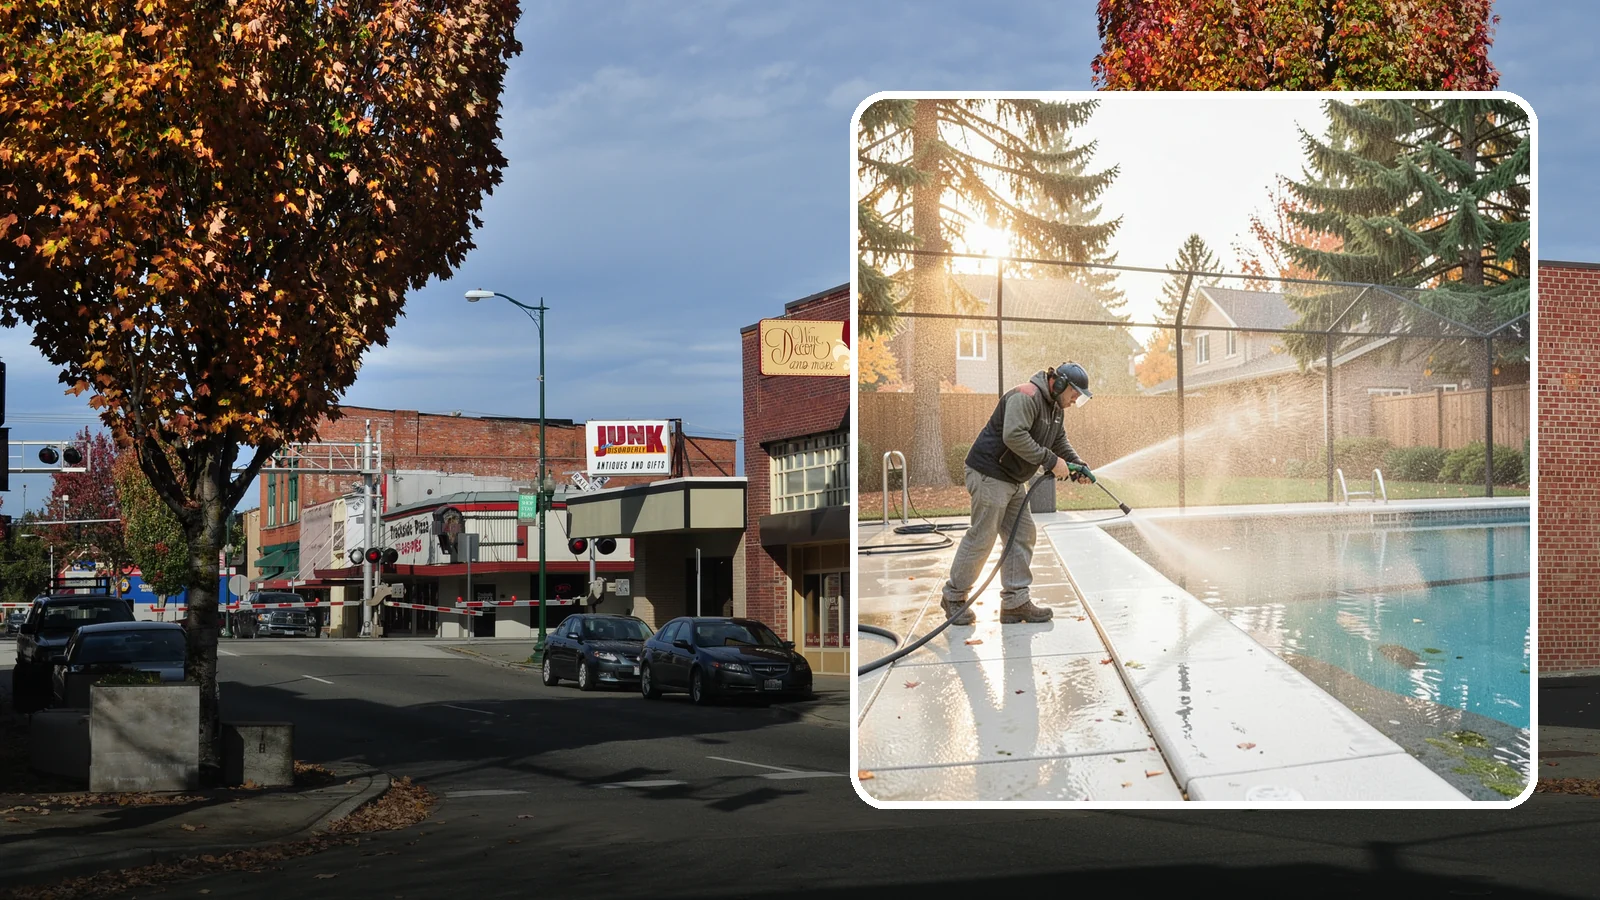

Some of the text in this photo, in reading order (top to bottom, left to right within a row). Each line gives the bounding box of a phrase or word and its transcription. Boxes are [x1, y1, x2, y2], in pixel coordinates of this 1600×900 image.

[595, 425, 665, 457] JUNK
[607, 446, 645, 454] DISORDERLY
[597, 460, 665, 470] ANTIQUES AND GIFTS
